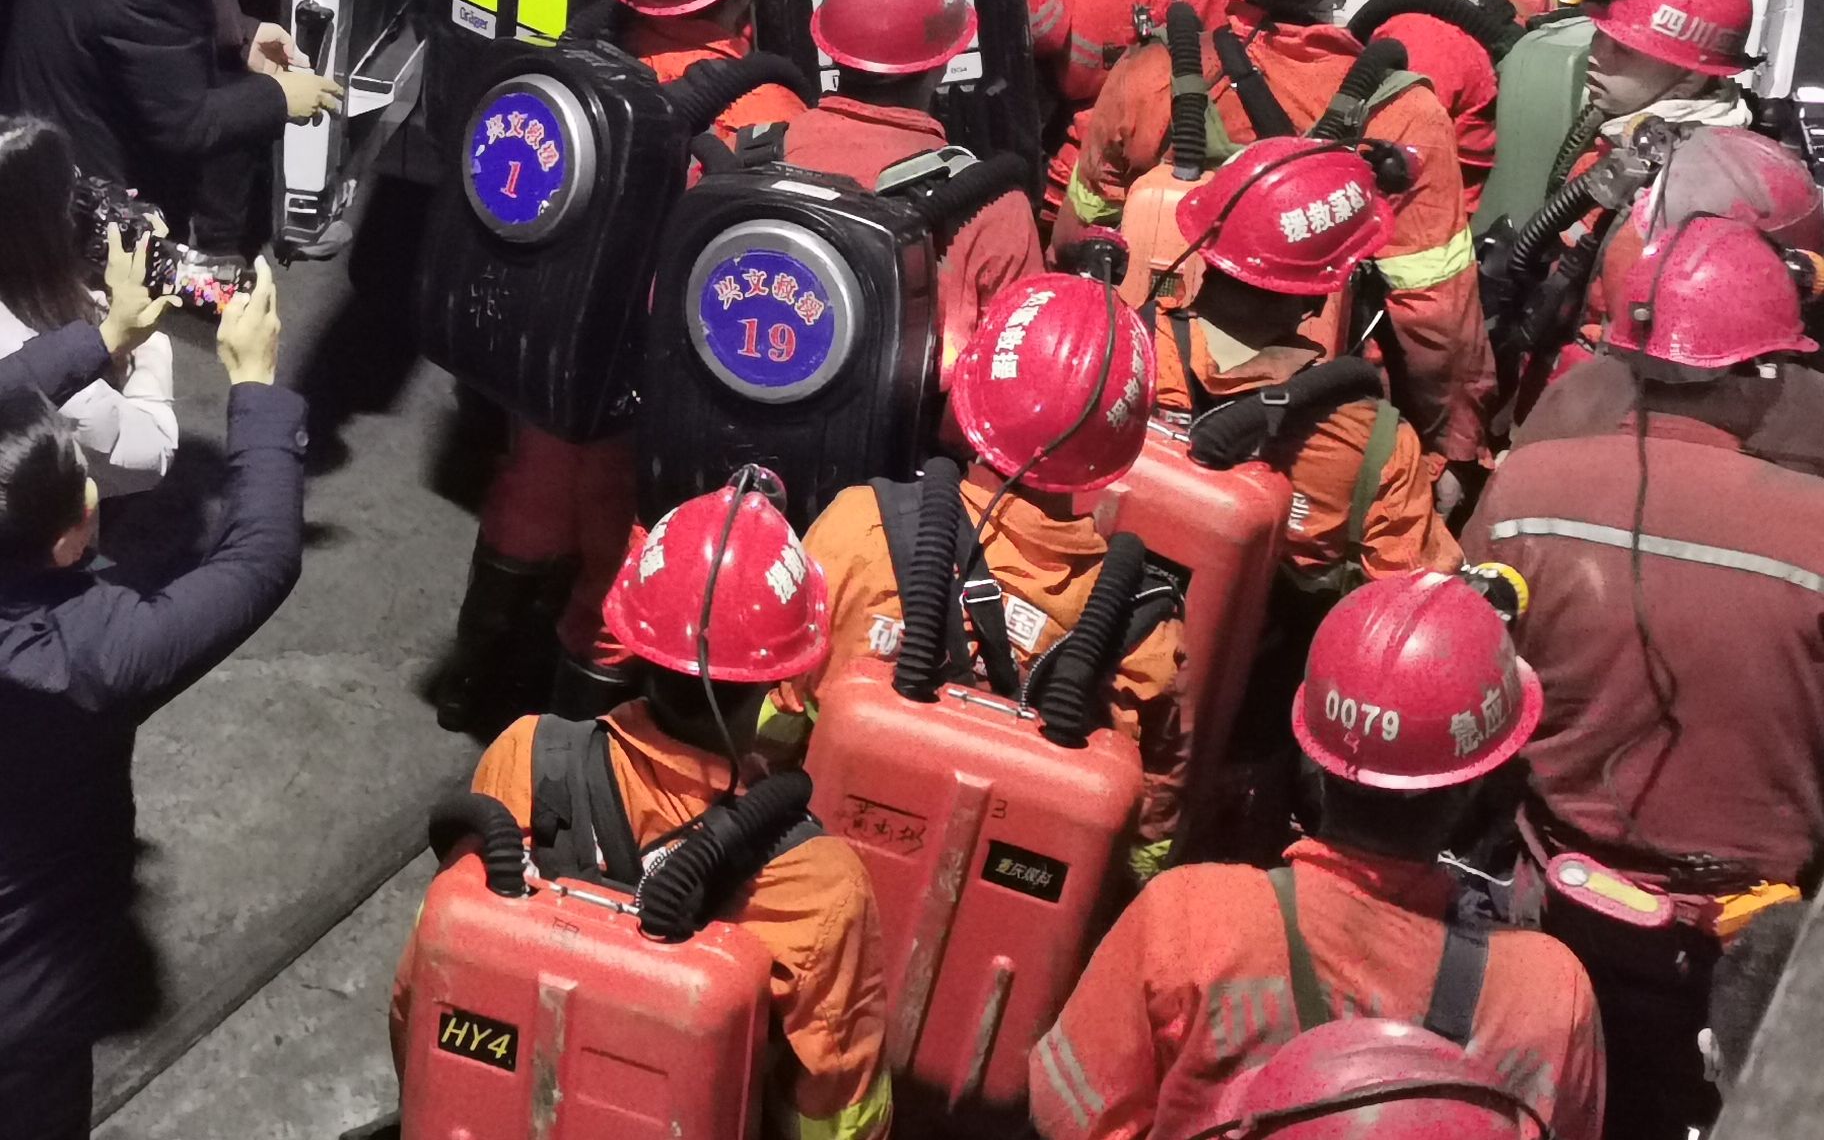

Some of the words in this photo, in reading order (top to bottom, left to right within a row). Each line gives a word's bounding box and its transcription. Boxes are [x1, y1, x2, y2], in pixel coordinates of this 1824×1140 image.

[499, 160, 522, 199] 1
[736, 317, 797, 363] 19
[1326, 689, 1400, 742] 0079
[440, 1016, 513, 1060] HY4
